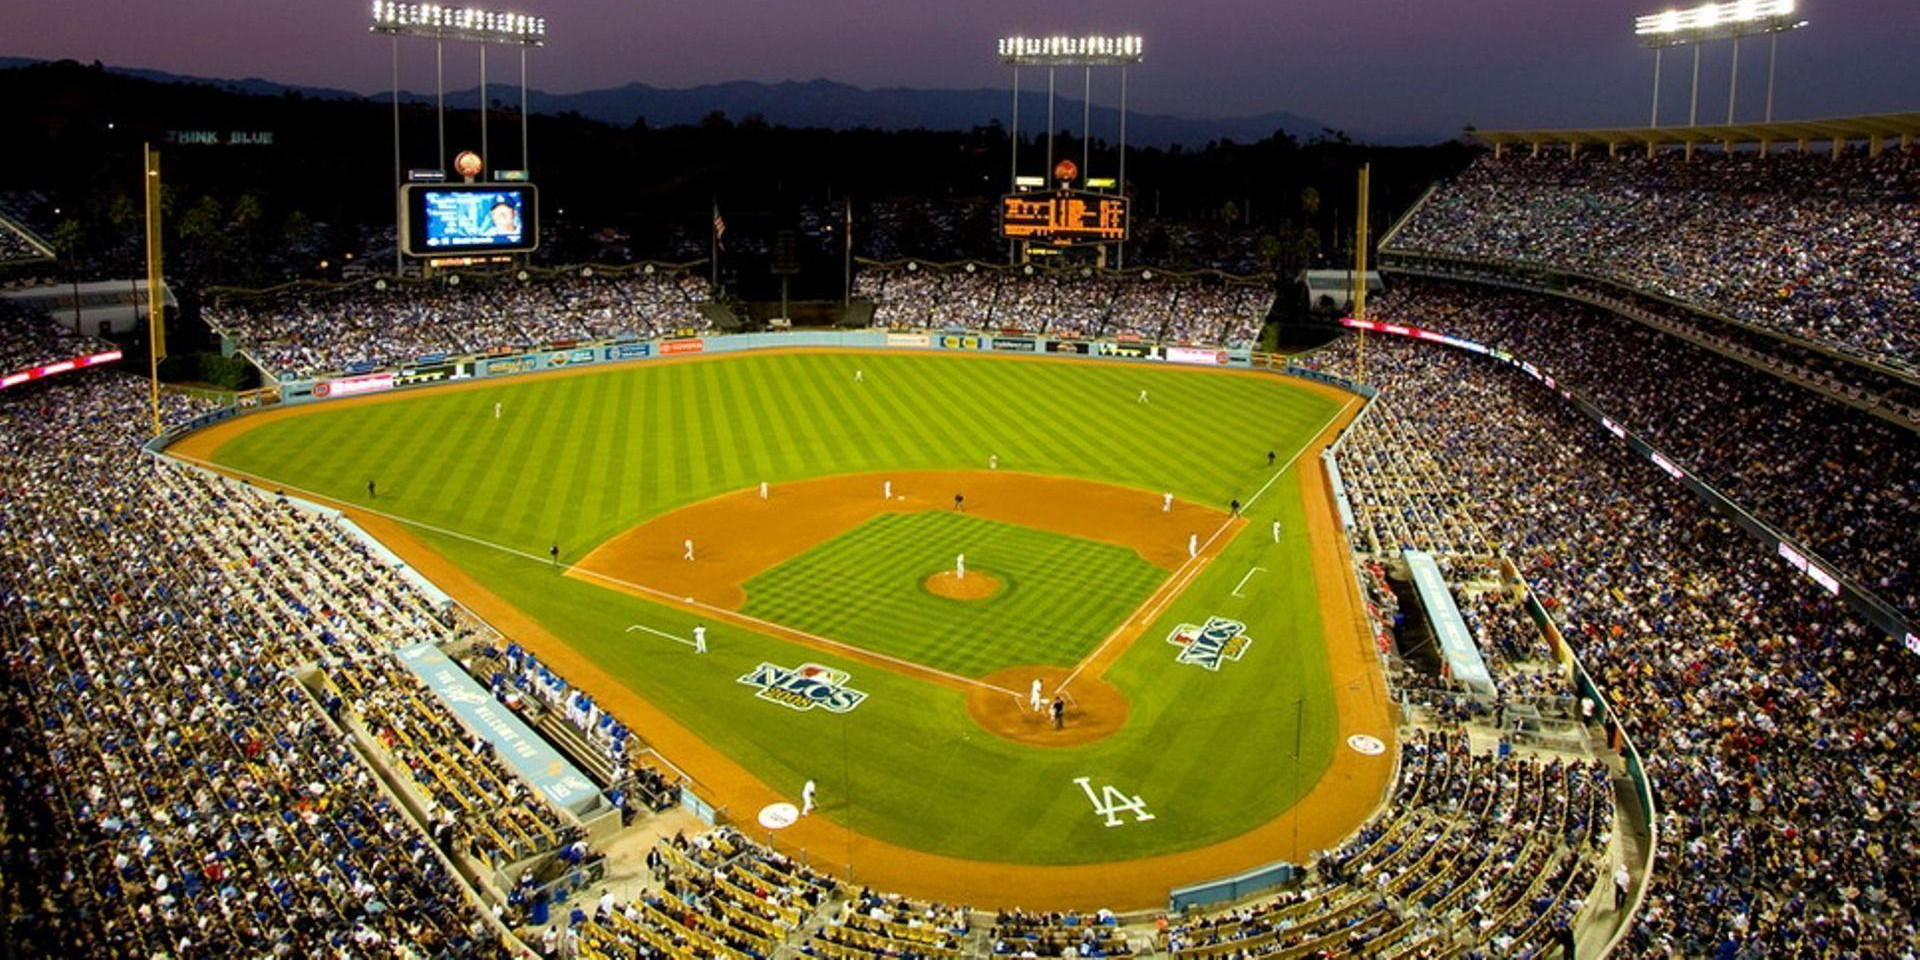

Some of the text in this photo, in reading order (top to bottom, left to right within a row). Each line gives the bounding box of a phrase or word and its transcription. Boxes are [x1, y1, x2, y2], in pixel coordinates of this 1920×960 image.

[166, 131, 273, 145] THINK BLUE
[1179, 616, 1245, 669] NLCS
[740, 663, 864, 710] NLCS
[762, 685, 814, 707] 2008
[1072, 776, 1156, 828] LA
